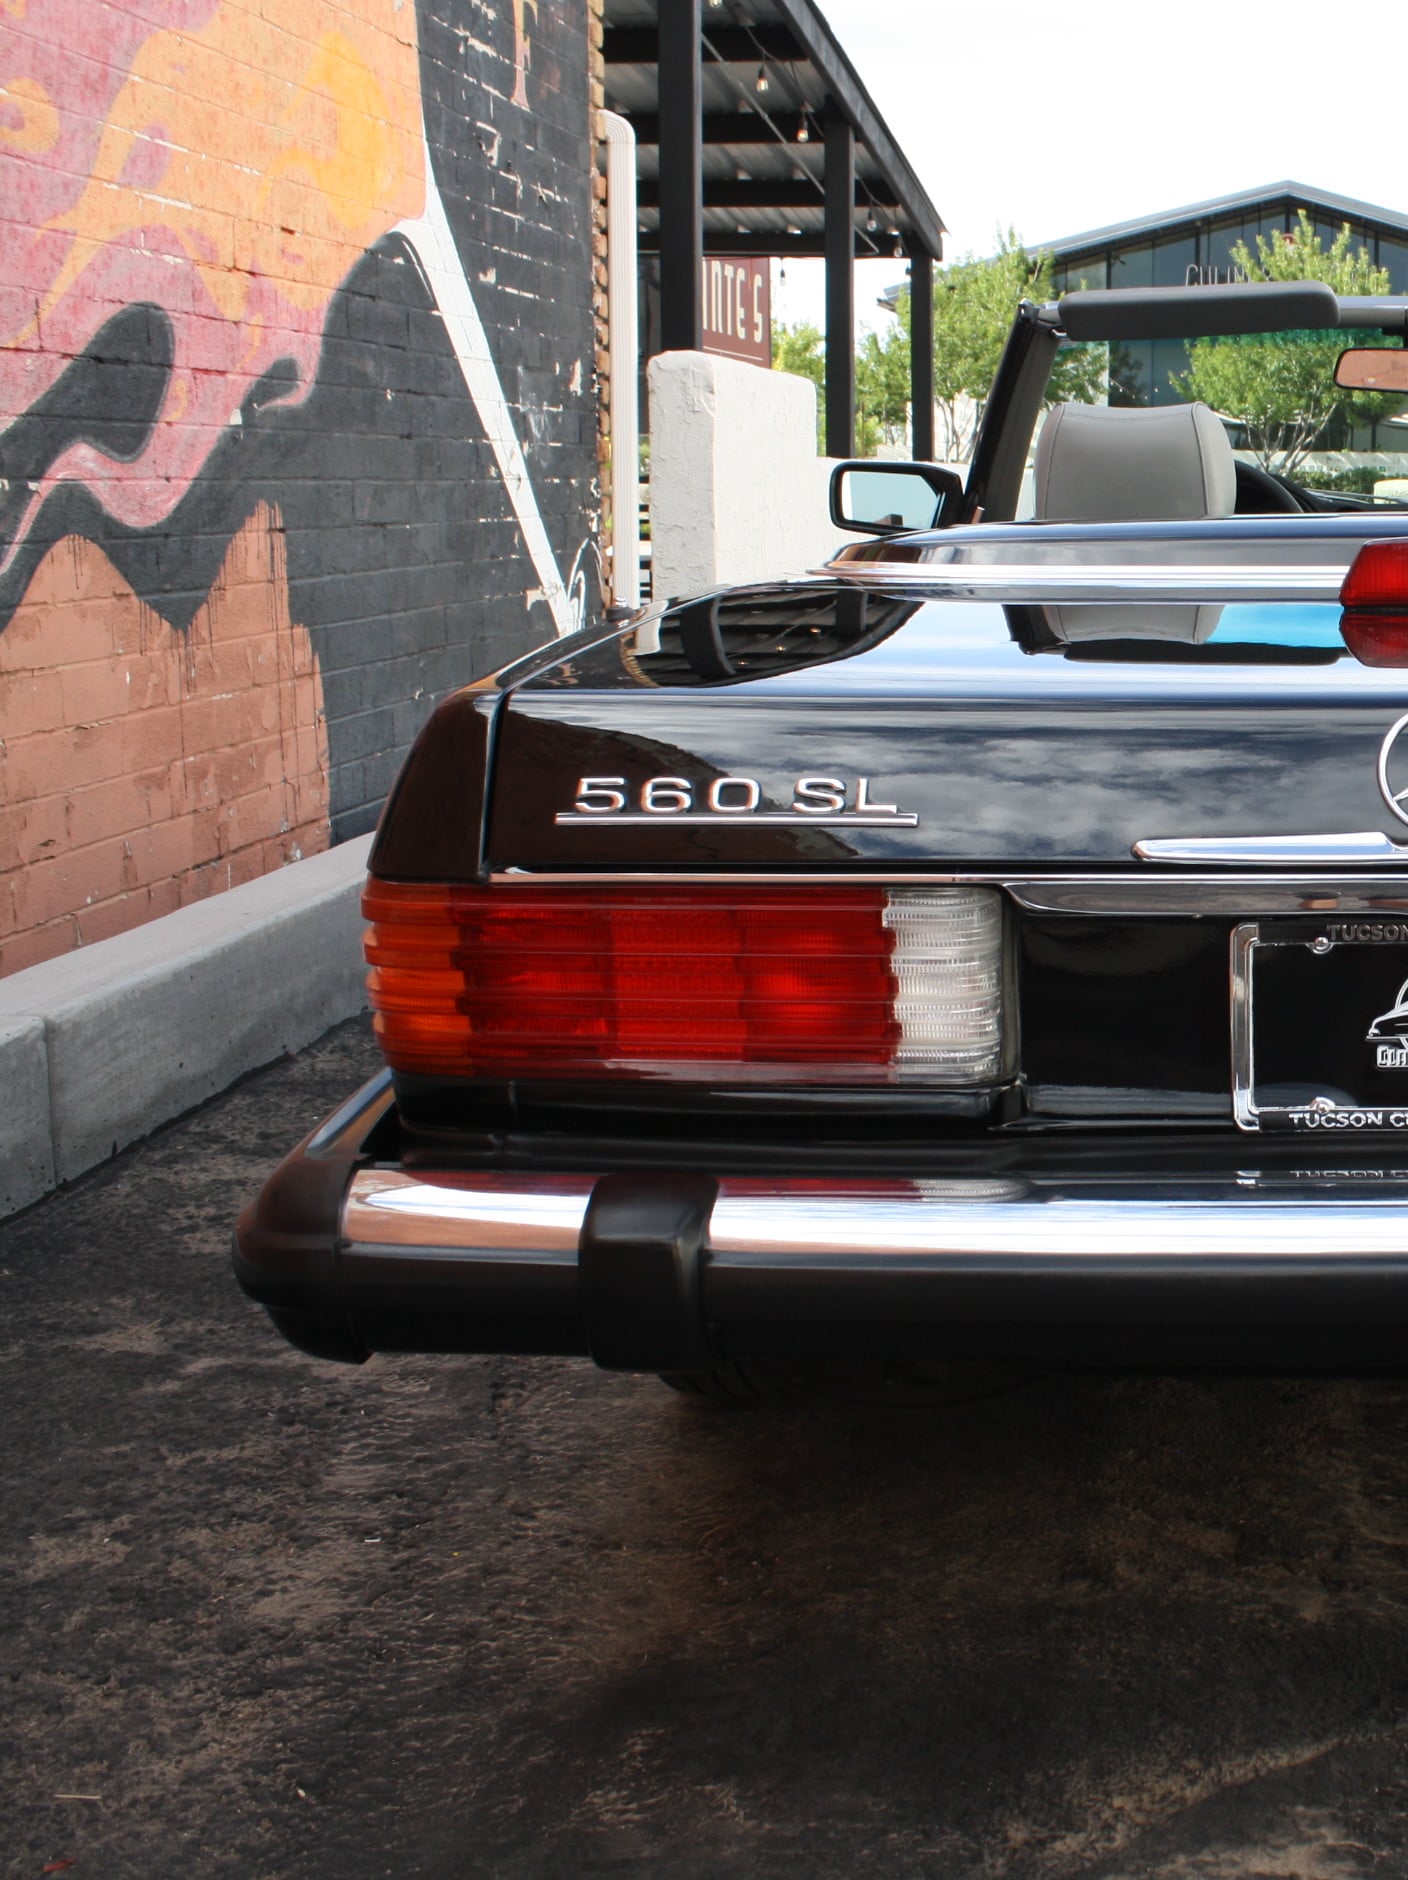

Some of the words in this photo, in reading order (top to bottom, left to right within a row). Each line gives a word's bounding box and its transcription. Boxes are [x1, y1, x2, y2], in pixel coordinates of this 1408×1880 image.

[574, 776, 761, 814] 560
[792, 776, 898, 814] SL
[1289, 1112, 1383, 1128] TUCSON
